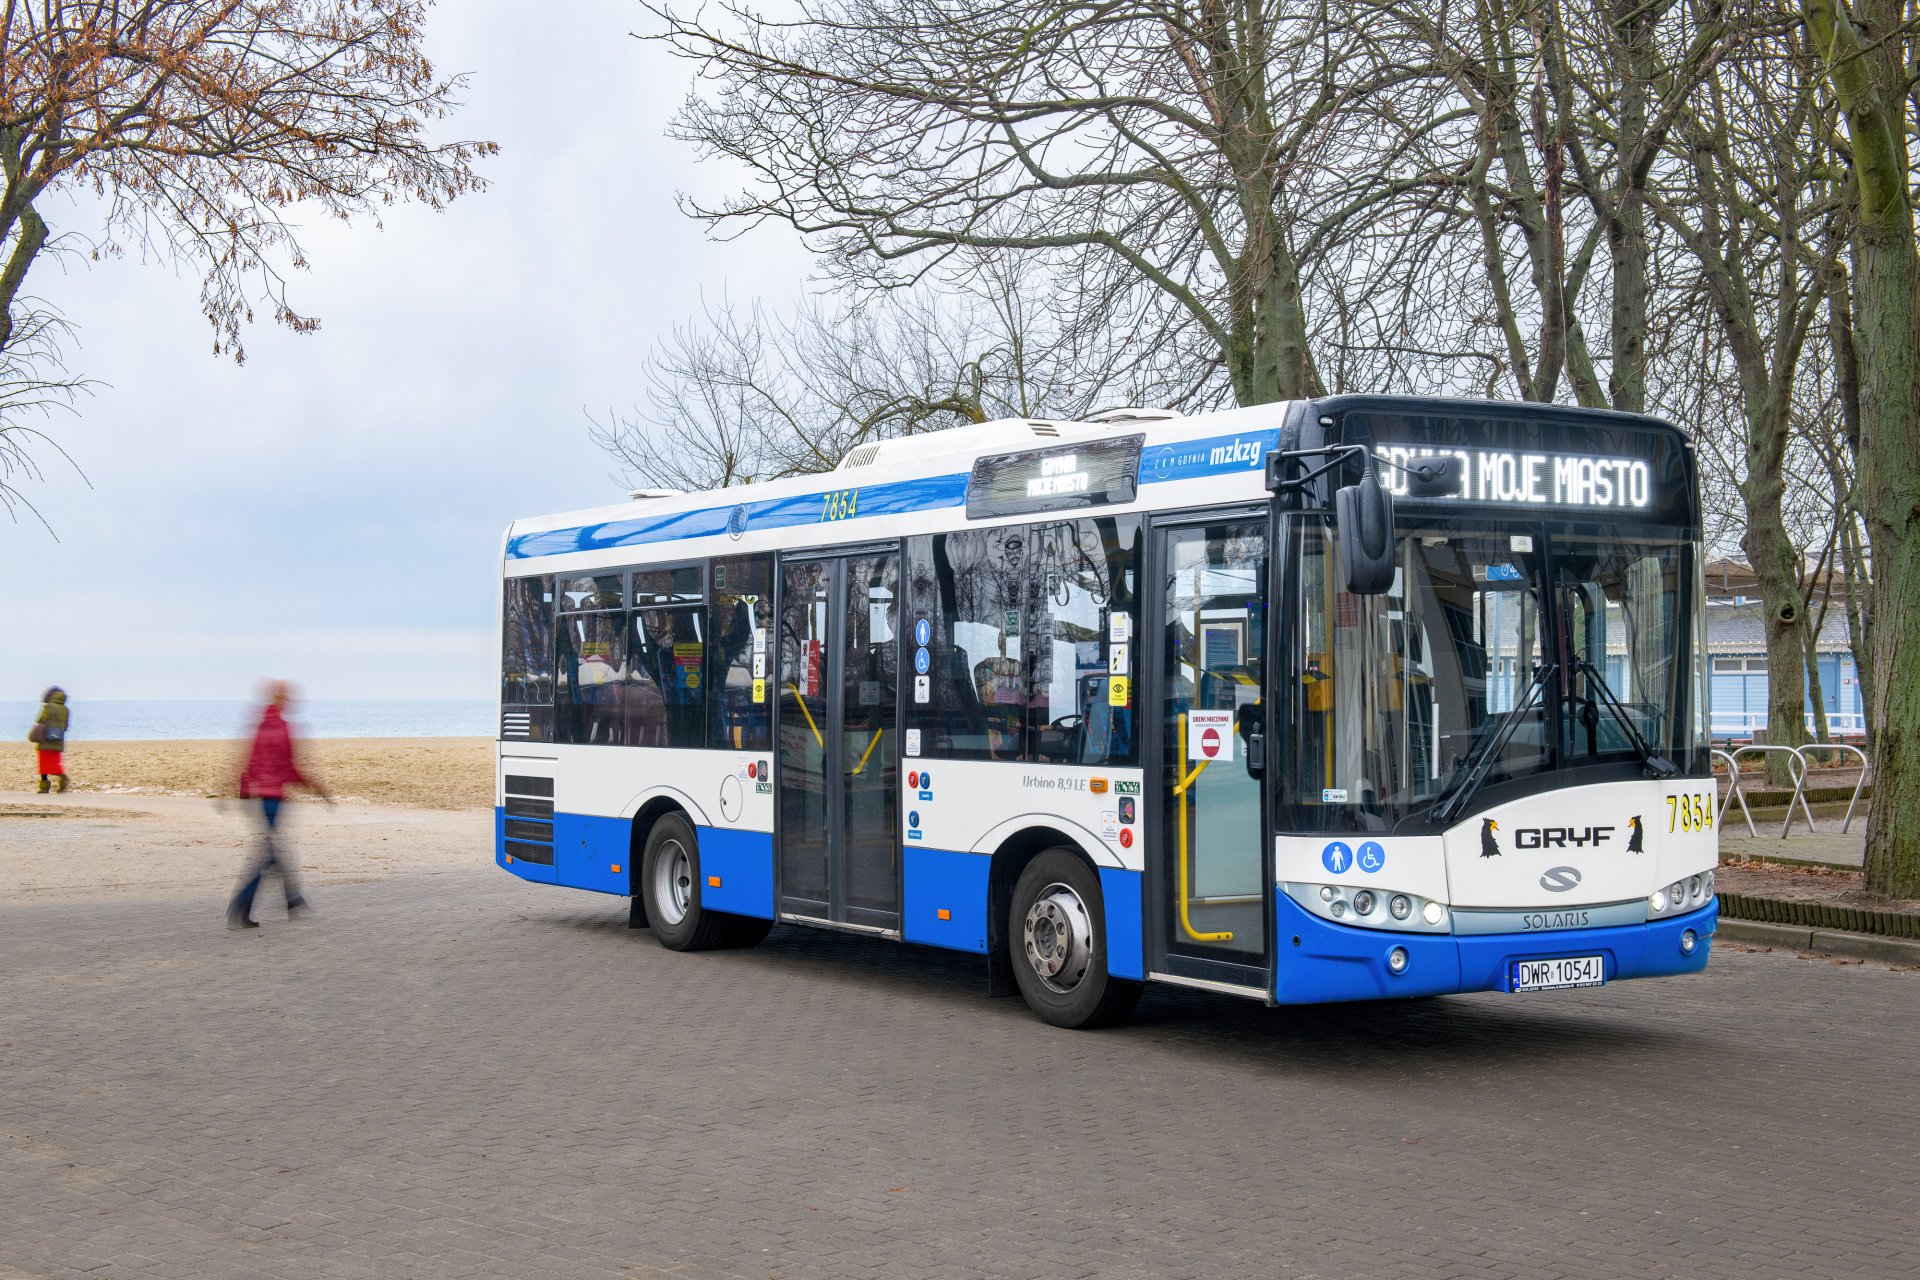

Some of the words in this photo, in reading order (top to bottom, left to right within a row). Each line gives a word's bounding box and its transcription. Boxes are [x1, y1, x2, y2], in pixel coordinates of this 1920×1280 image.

[1178, 452, 1205, 466] GDYNIA
[1209, 438, 1262, 466] mzkzg
[1377, 446, 1471, 500] GDA
[1479, 452, 1547, 502] MOJE
[1554, 455, 1649, 507] MIASTO
[821, 487, 859, 522] 7854
[1023, 775, 1056, 789] Urbino
[1074, 779, 1087, 792] LE
[1666, 792, 1713, 833] 7854
[1515, 826, 1616, 849] GRYF
[1523, 911, 1590, 930] SOLARIS
[1521, 962, 1550, 986] DWR
[1556, 958, 1599, 983] 1054J
